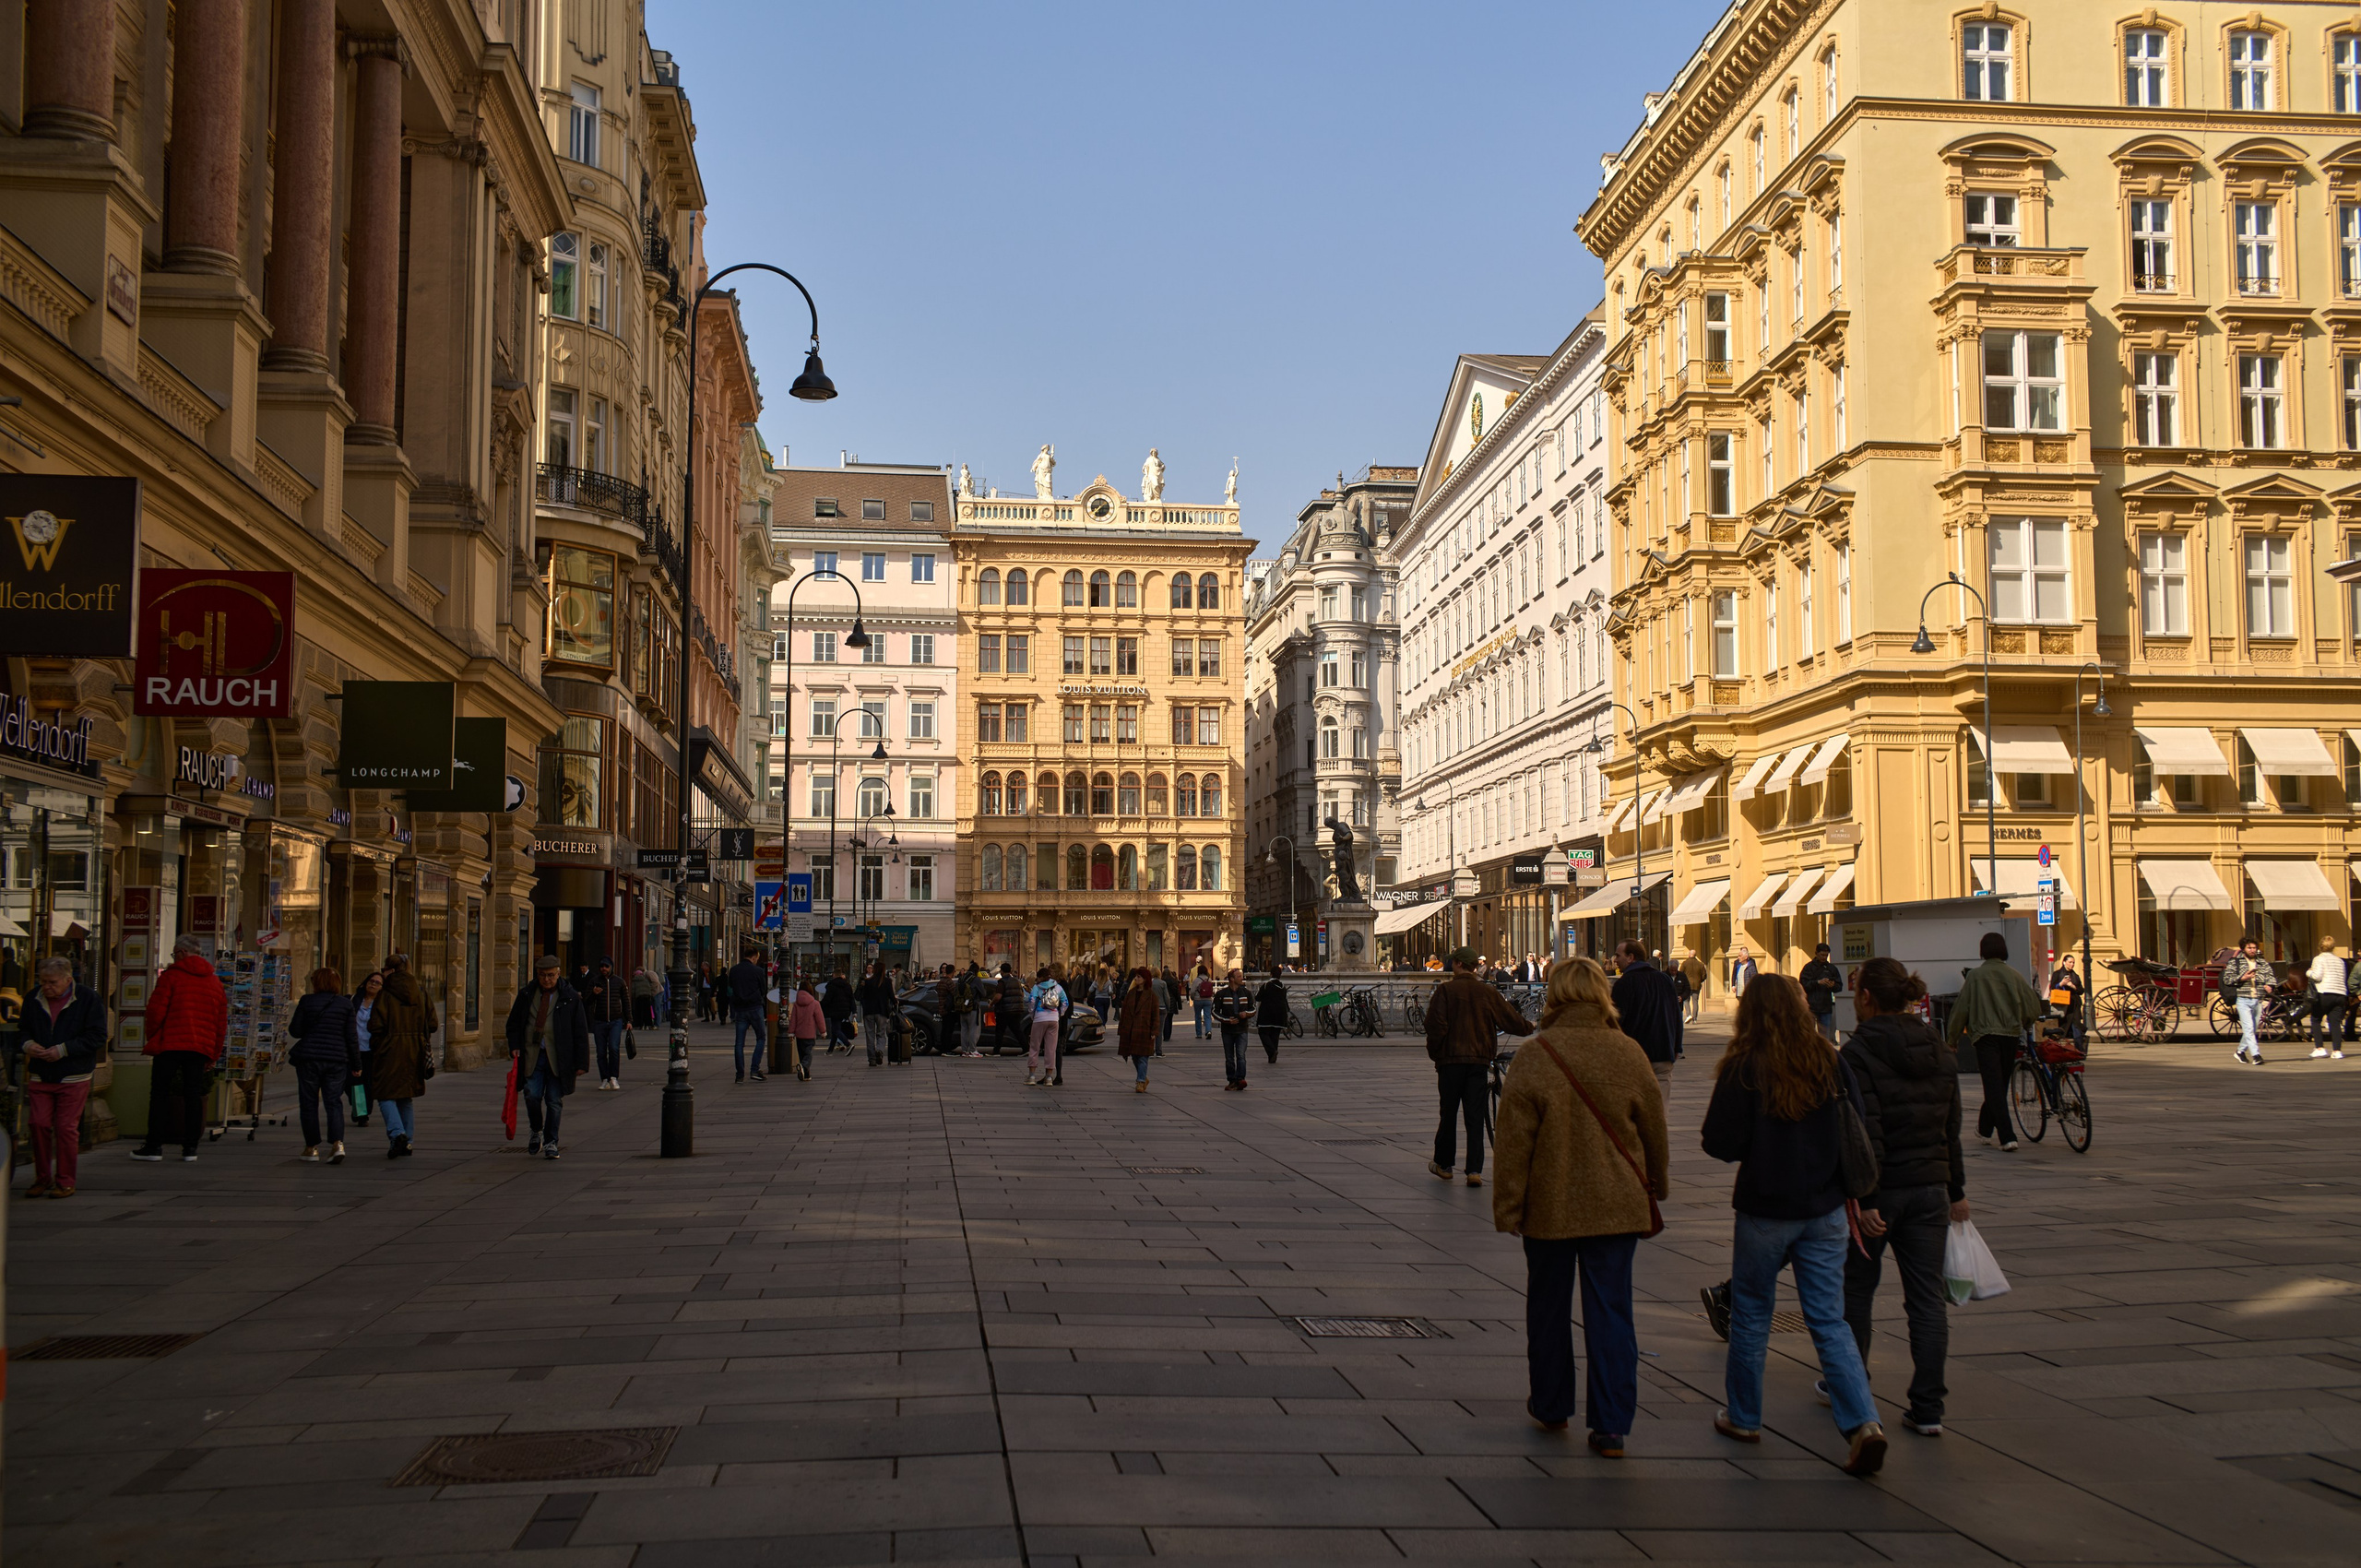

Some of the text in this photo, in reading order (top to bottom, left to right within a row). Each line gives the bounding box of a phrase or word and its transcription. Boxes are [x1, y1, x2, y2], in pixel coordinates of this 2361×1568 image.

[0, 583, 120, 612] llendorff
[147, 677, 278, 707] RAUCH
[1058, 683, 1146, 695] LOUIS VUITTON
[181, 746, 227, 791] RAUCH
[351, 767, 441, 778] LONGCHAMP
[534, 840, 597, 854] BUCHERER
[643, 854, 693, 863] BUCHERR
[1376, 891, 1418, 901] WAGNER
[2040, 912, 2052, 921] Zone
